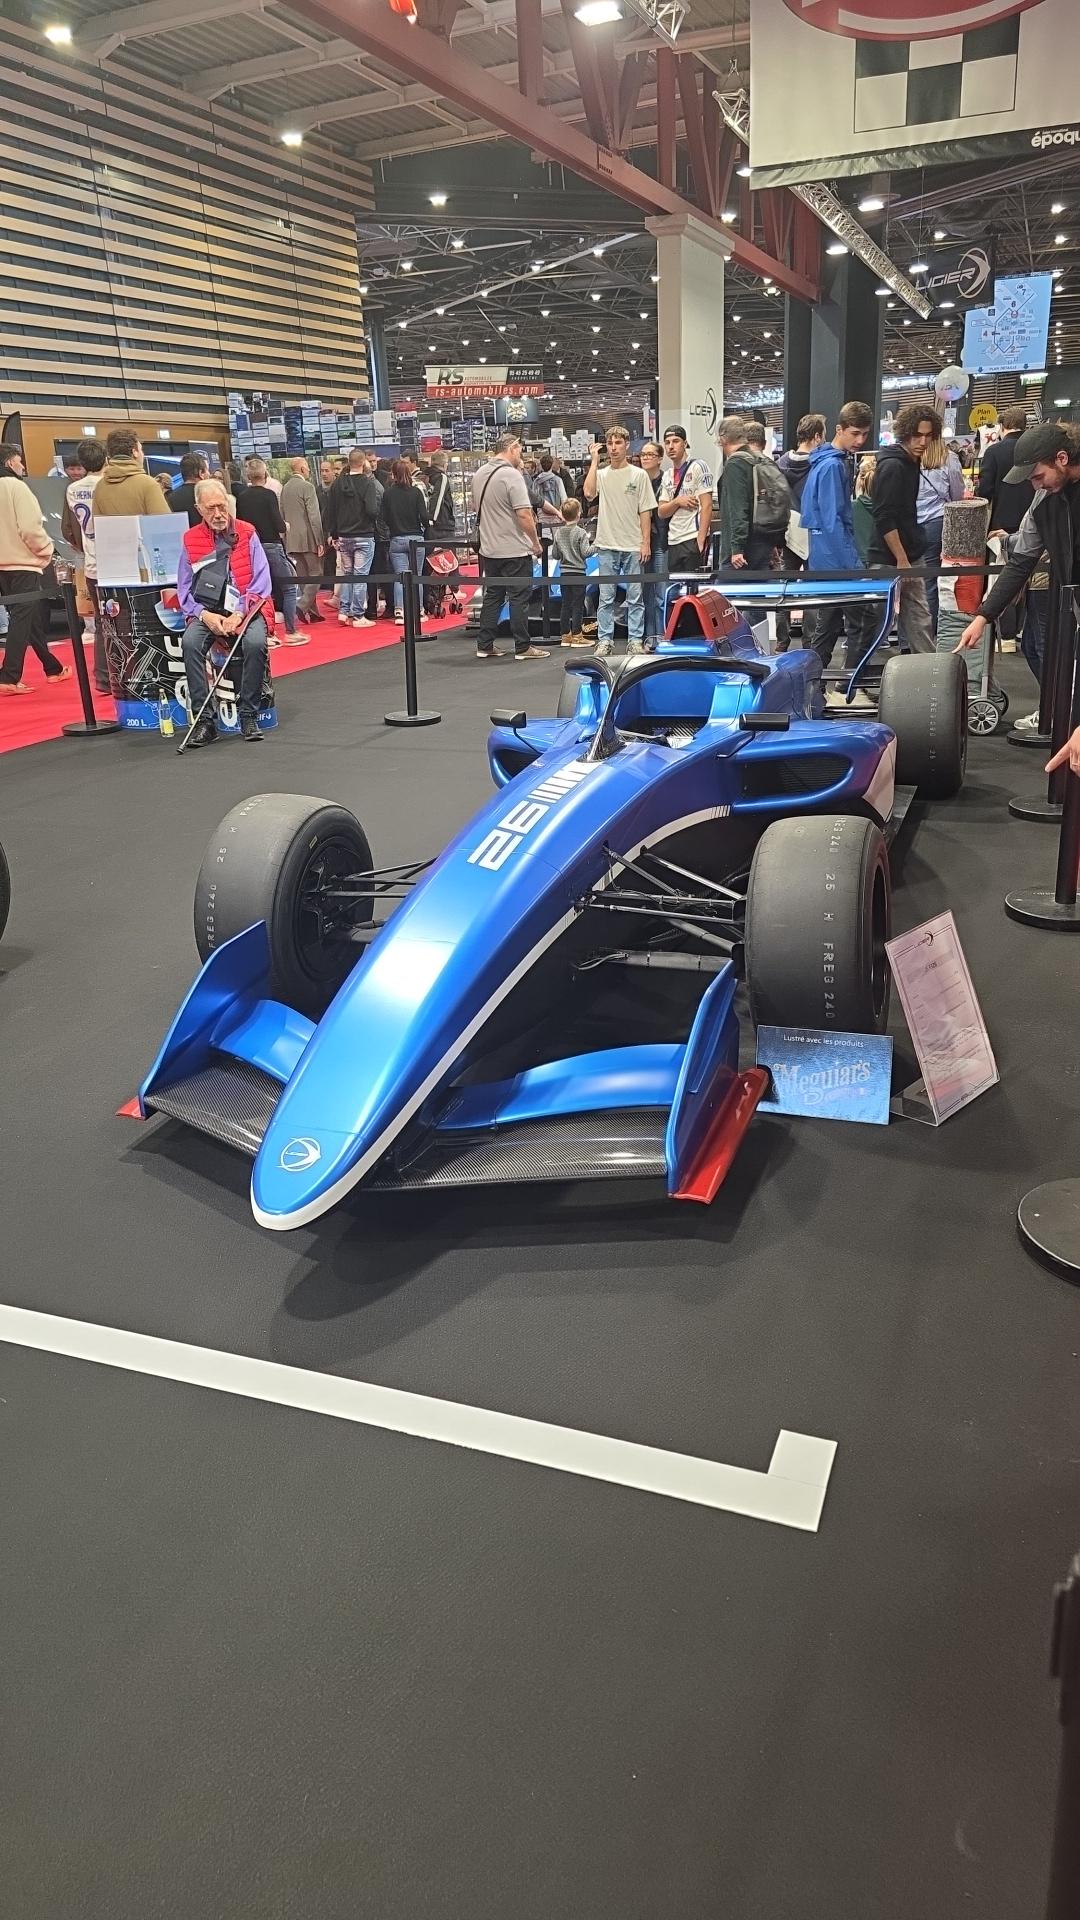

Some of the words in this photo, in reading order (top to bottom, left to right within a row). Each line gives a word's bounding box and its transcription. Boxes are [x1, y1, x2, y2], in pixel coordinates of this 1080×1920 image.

[437, 368, 465, 386] RS
[435, 386, 539, 397] rs-automobiles.com
[126, 718, 140, 727] 200
[466, 799, 551, 871] 26
[216, 847, 227, 863] 25
[825, 872, 836, 891] 25
[207, 884, 217, 909] 240
[206, 916, 216, 949] FREG
[823, 942, 834, 984] FREG
[824, 992, 836, 1019] 240
[823, 1036, 833, 1045] les
[834, 1039, 864, 1048] produits
[773, 1060, 871, 1098] Meguiar's
